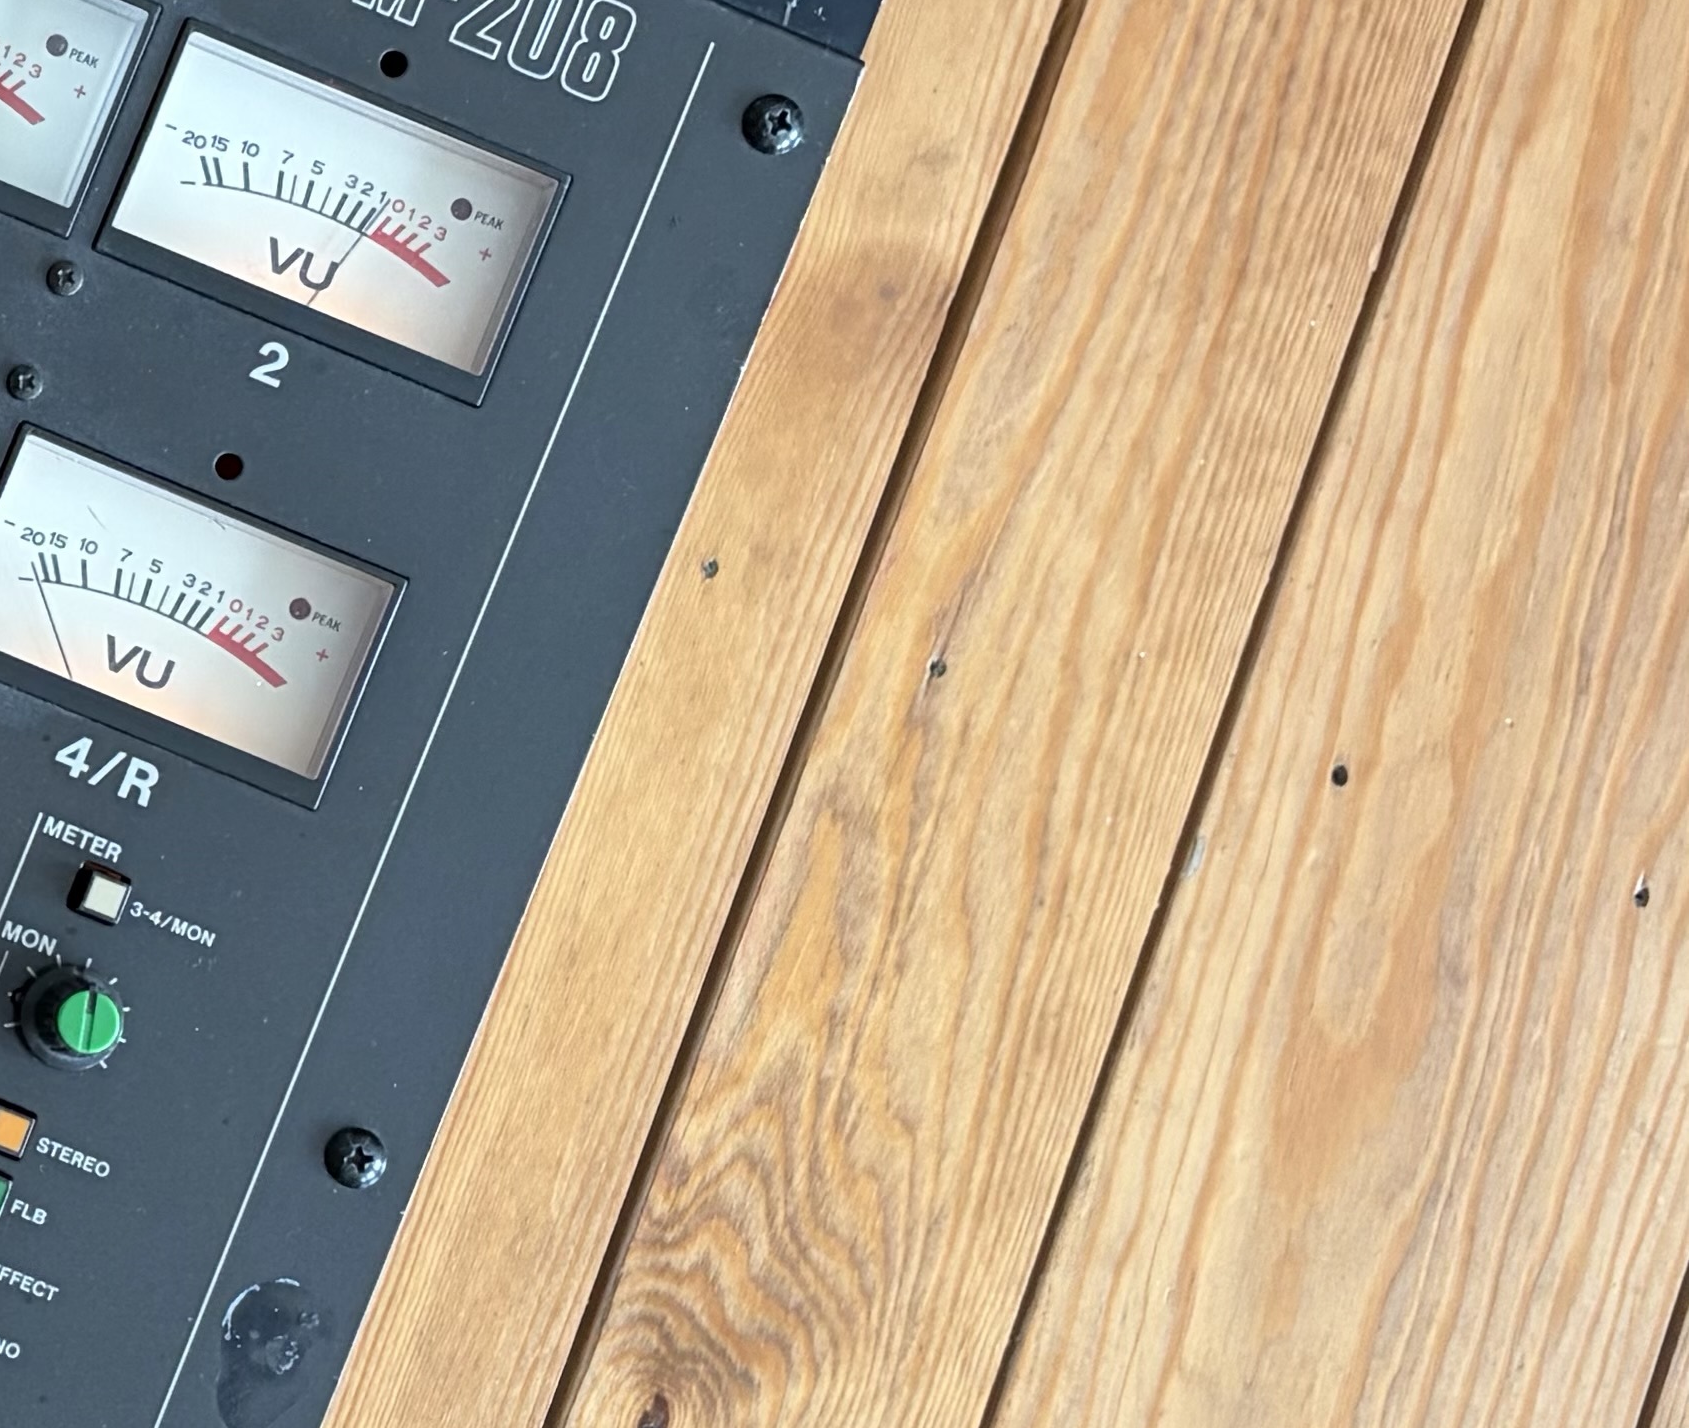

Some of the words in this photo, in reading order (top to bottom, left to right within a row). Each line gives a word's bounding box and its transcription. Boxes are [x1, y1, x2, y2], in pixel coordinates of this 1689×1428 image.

[68, 47, 99, 69] PEAK
[473, 210, 505, 231] PEAK
[269, 236, 344, 296] VU
[248, 341, 290, 388] 2
[19, 526, 46, 547] 20
[48, 531, 69, 550] 15
[311, 611, 343, 633] PEAK
[106, 633, 176, 690] VU
[54, 736, 160, 808] 4/R
[42, 815, 123, 863] METER
[0, 919, 58, 957] MON
[129, 901, 217, 948] 3-4/MON
[35, 1136, 111, 1178] STEREO
[9, 1198, 48, 1226] FLB
